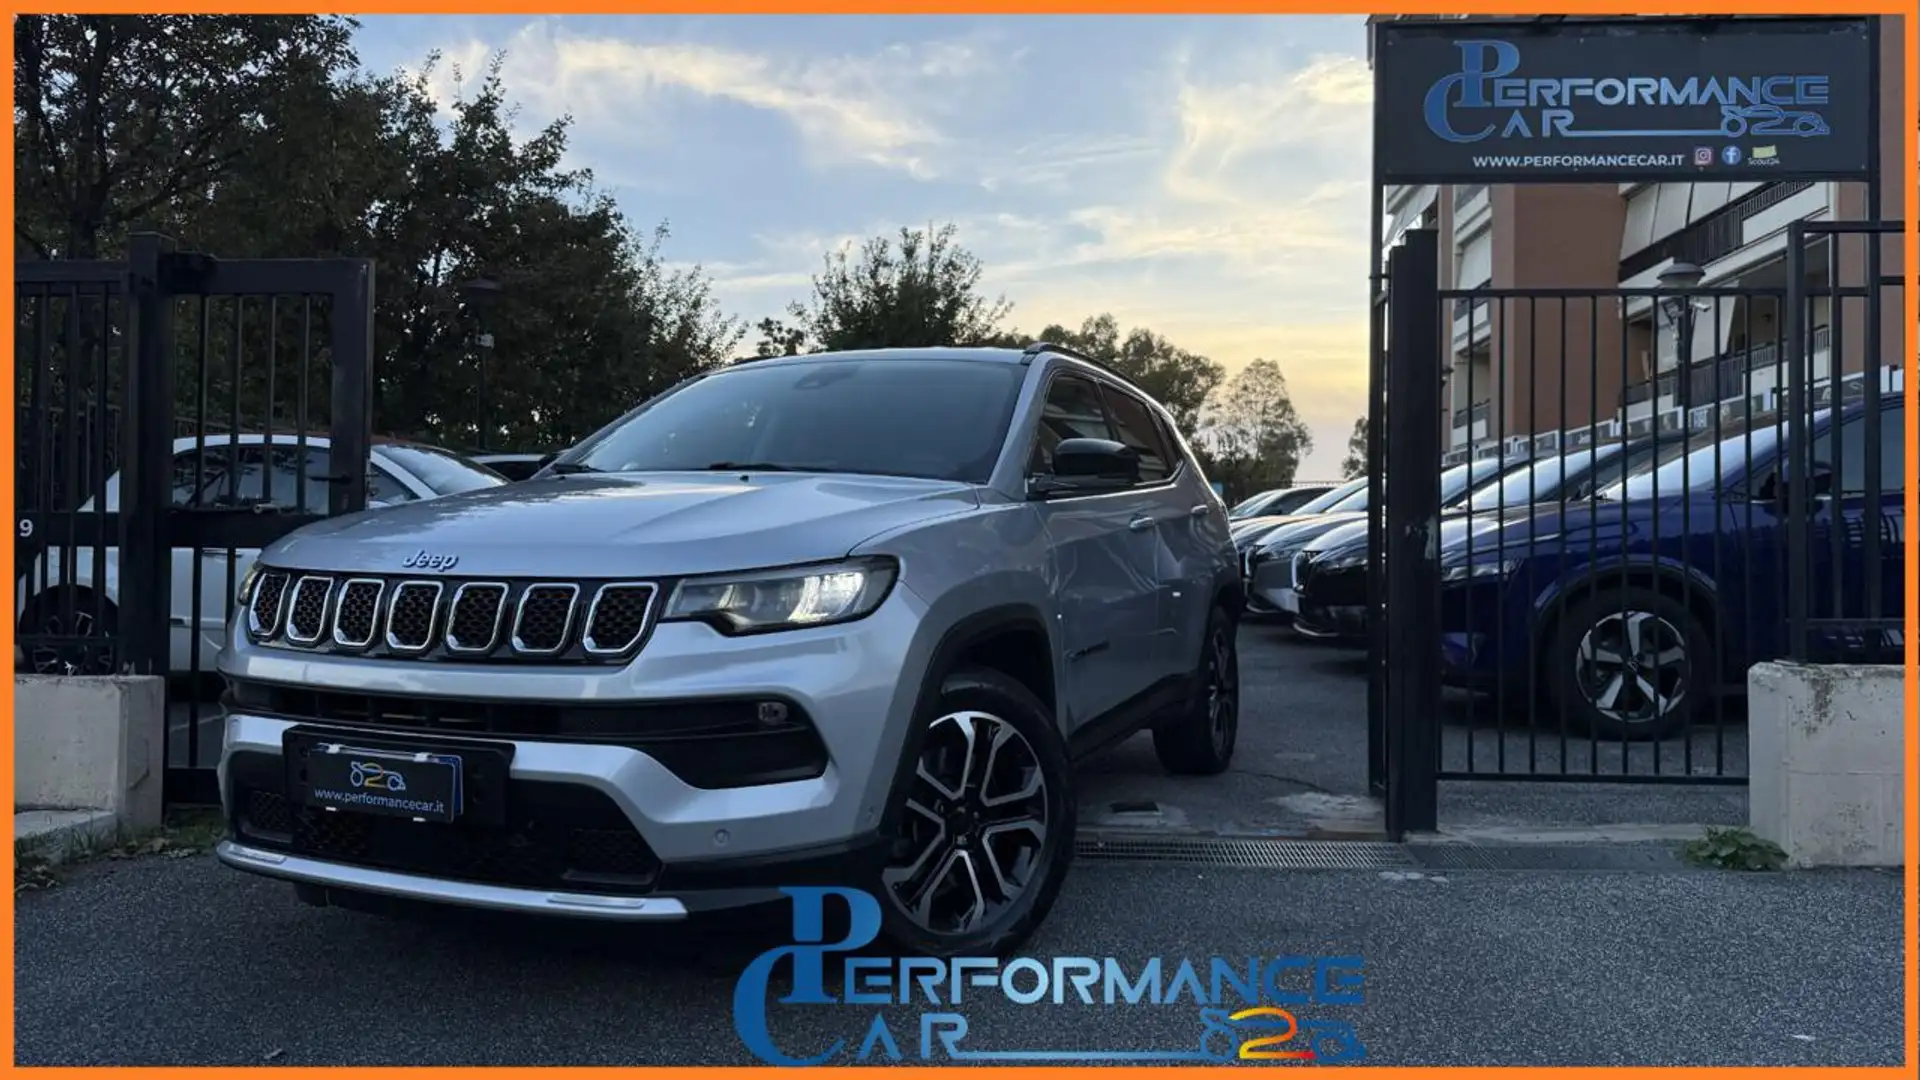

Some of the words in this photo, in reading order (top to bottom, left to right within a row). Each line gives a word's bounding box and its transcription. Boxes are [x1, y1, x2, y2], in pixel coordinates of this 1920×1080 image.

[1453, 40, 1829, 107] PERFORMANCE
[1424, 72, 1577, 143] CAR
[1473, 153, 1685, 168] WWW.PERFORMANCECAR.IT
[19, 518, 33, 537] 9
[402, 549, 459, 572] Jeep
[314, 789, 445, 813] www.performancecar.it
